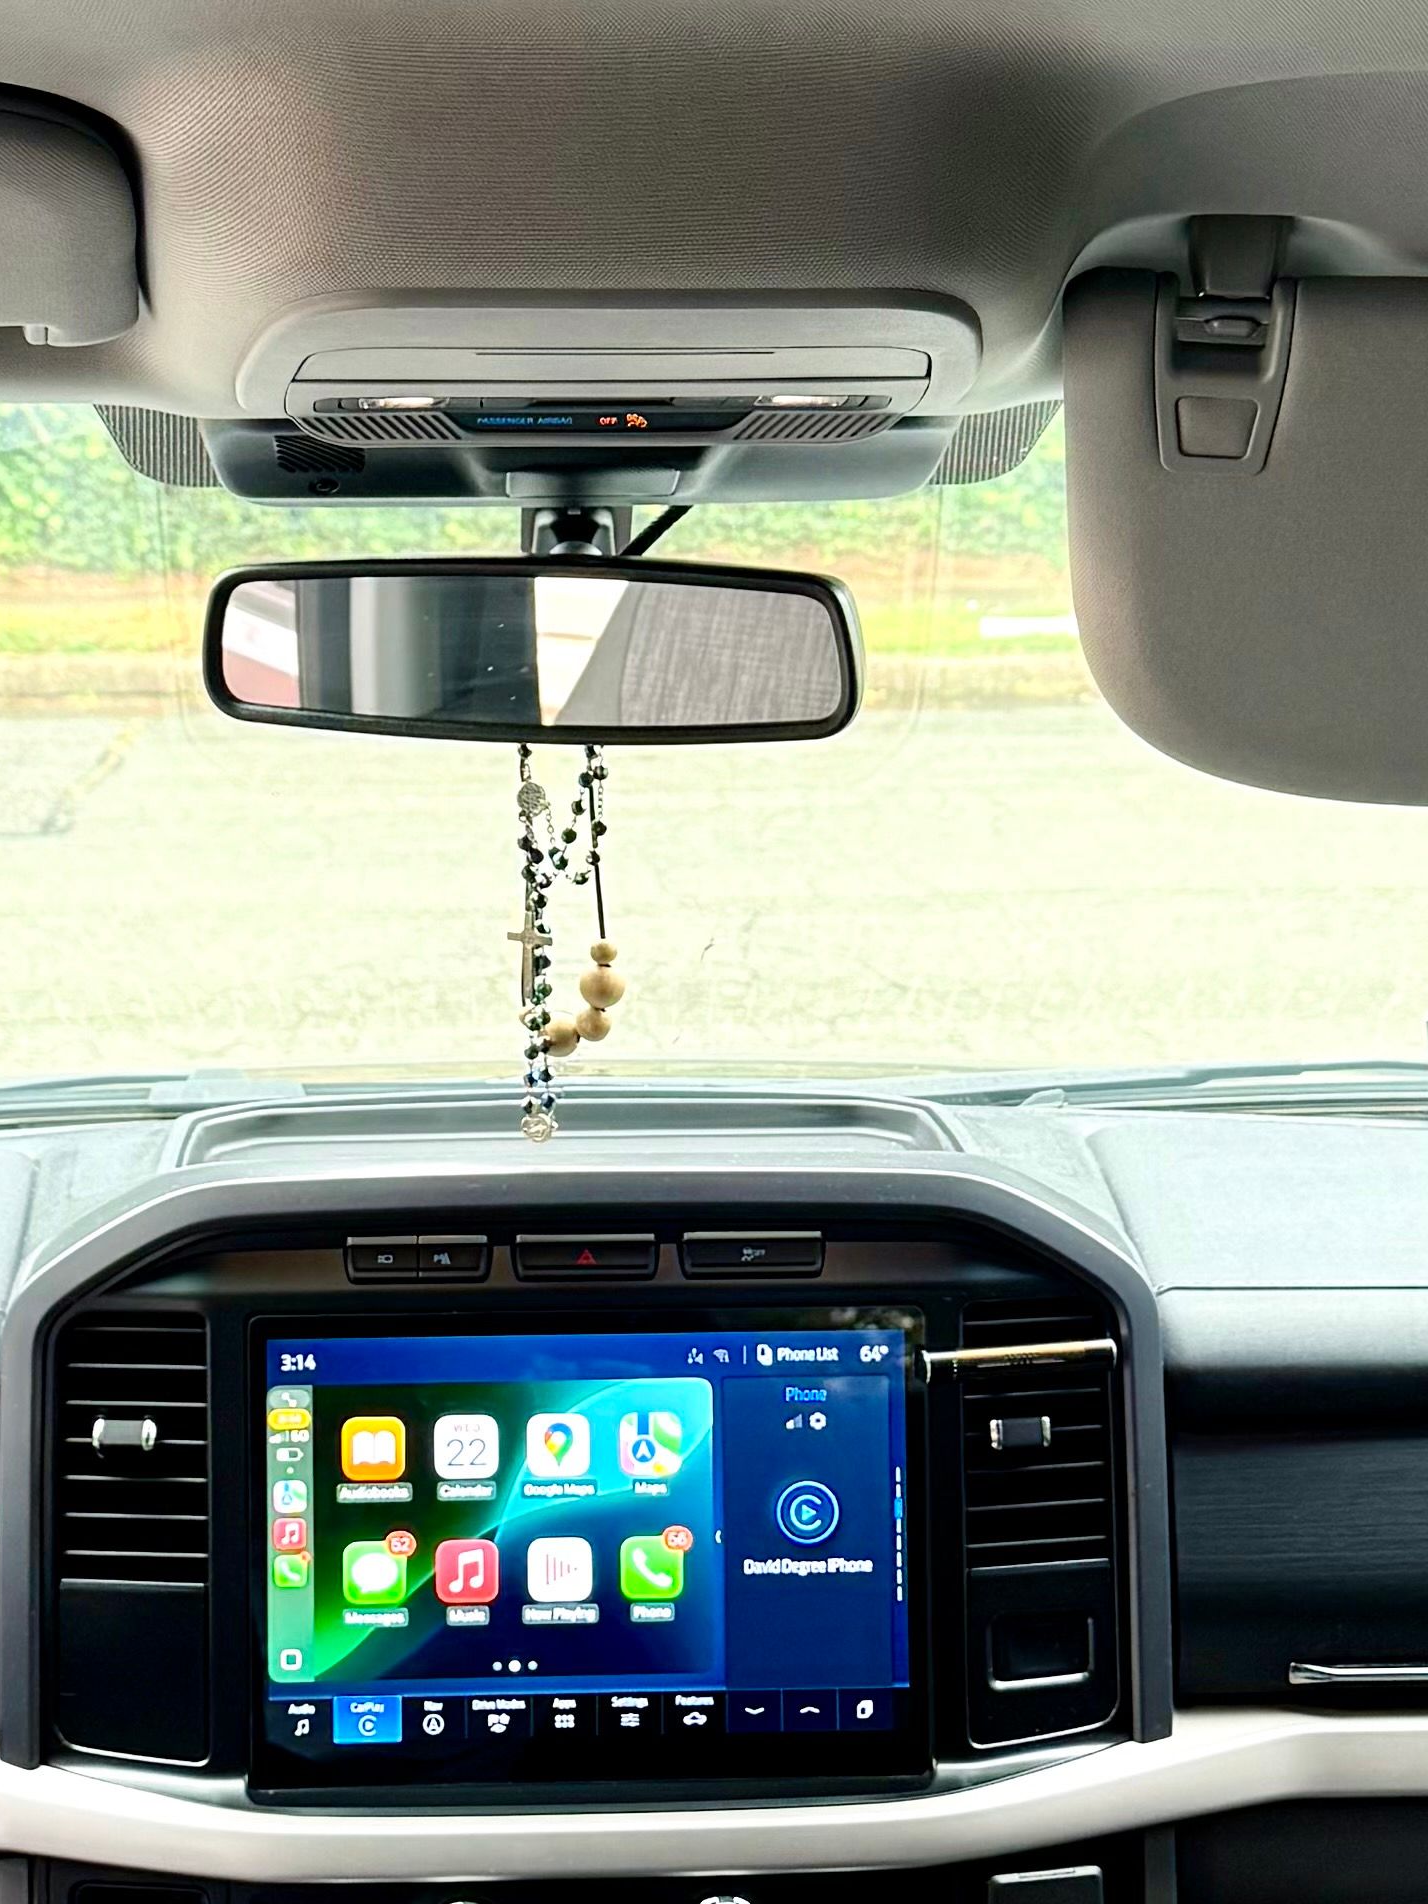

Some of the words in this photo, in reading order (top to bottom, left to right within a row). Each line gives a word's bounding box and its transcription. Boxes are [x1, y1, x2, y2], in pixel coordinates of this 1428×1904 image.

[537, 416, 573, 426] AIRBAG
[599, 416, 618, 426] OFF
[777, 1347, 815, 1362] Phone
[815, 1346, 839, 1361] List
[859, 1344, 890, 1363] 64°
[280, 1353, 317, 1372] 3:14
[784, 1386, 828, 1403] Phone
[446, 1438, 488, 1467] 22
[439, 1484, 494, 1498] Calendar
[523, 1483, 563, 1498] Google
[563, 1482, 596, 1497] Maps
[633, 1481, 668, 1496] Maps
[743, 1558, 780, 1575] David
[780, 1557, 827, 1576] Degree
[632, 1604, 672, 1619] Phone
[287, 1703, 316, 1715] Audio
